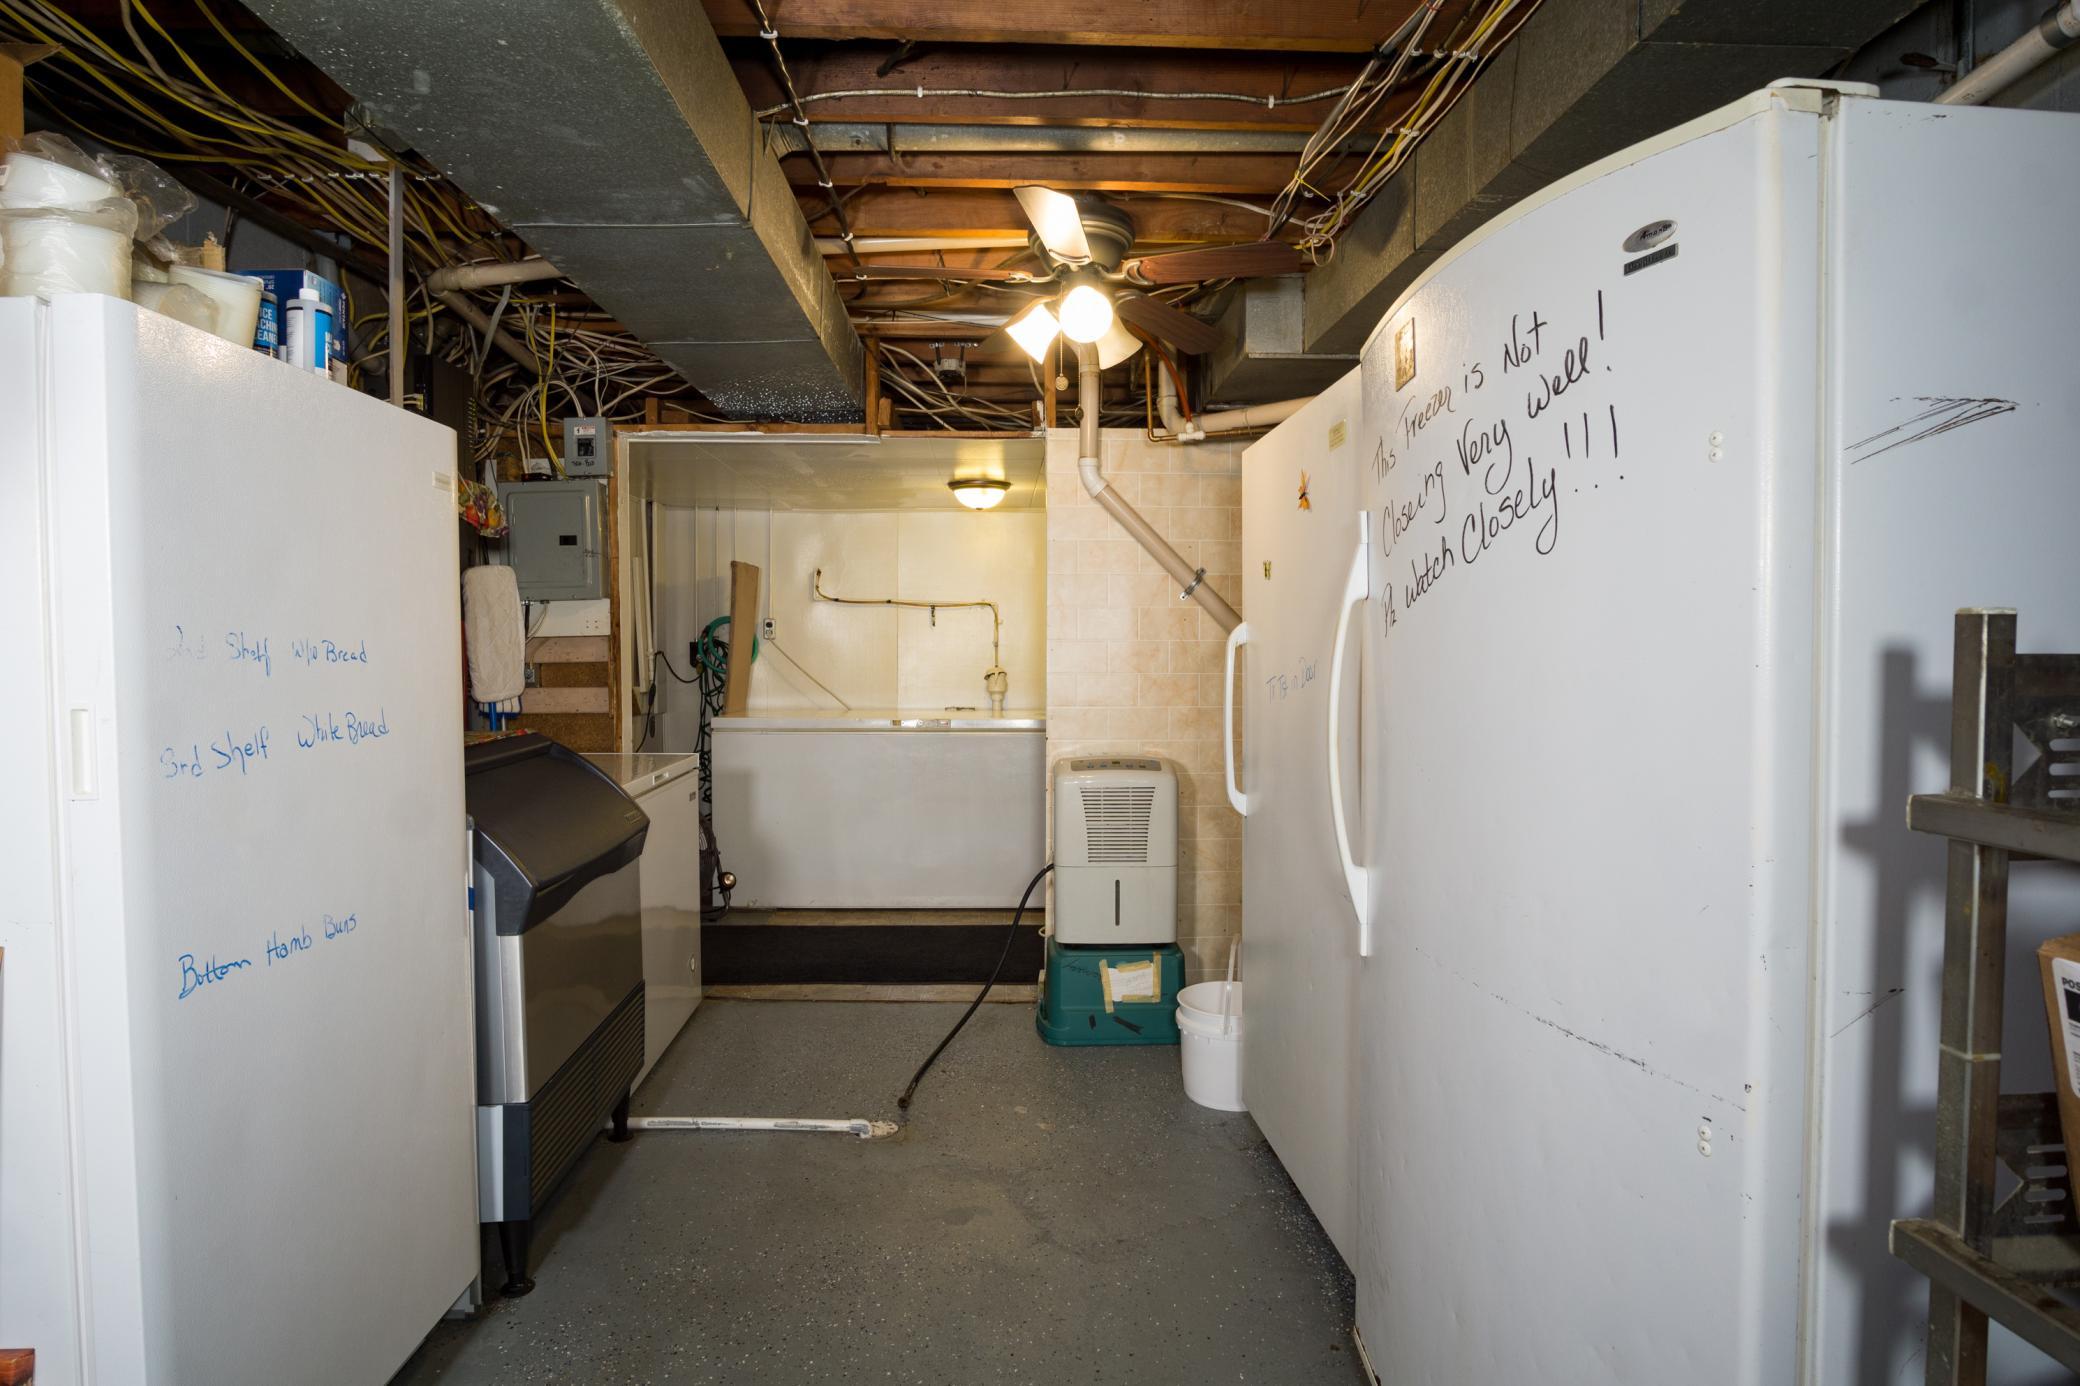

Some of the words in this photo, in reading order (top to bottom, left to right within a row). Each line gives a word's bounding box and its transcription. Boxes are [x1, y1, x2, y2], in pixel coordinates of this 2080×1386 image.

[1395, 386, 1457, 450] Freezer
[1462, 362, 1485, 394] is
[1503, 310, 1548, 374] Not
[1456, 417, 1513, 495] Very
[321, 639, 369, 664] Bread
[210, 725, 270, 775] Shelf
[297, 711, 344, 748] White
[345, 706, 390, 744] Bread
[178, 953, 252, 1000] Bottom
